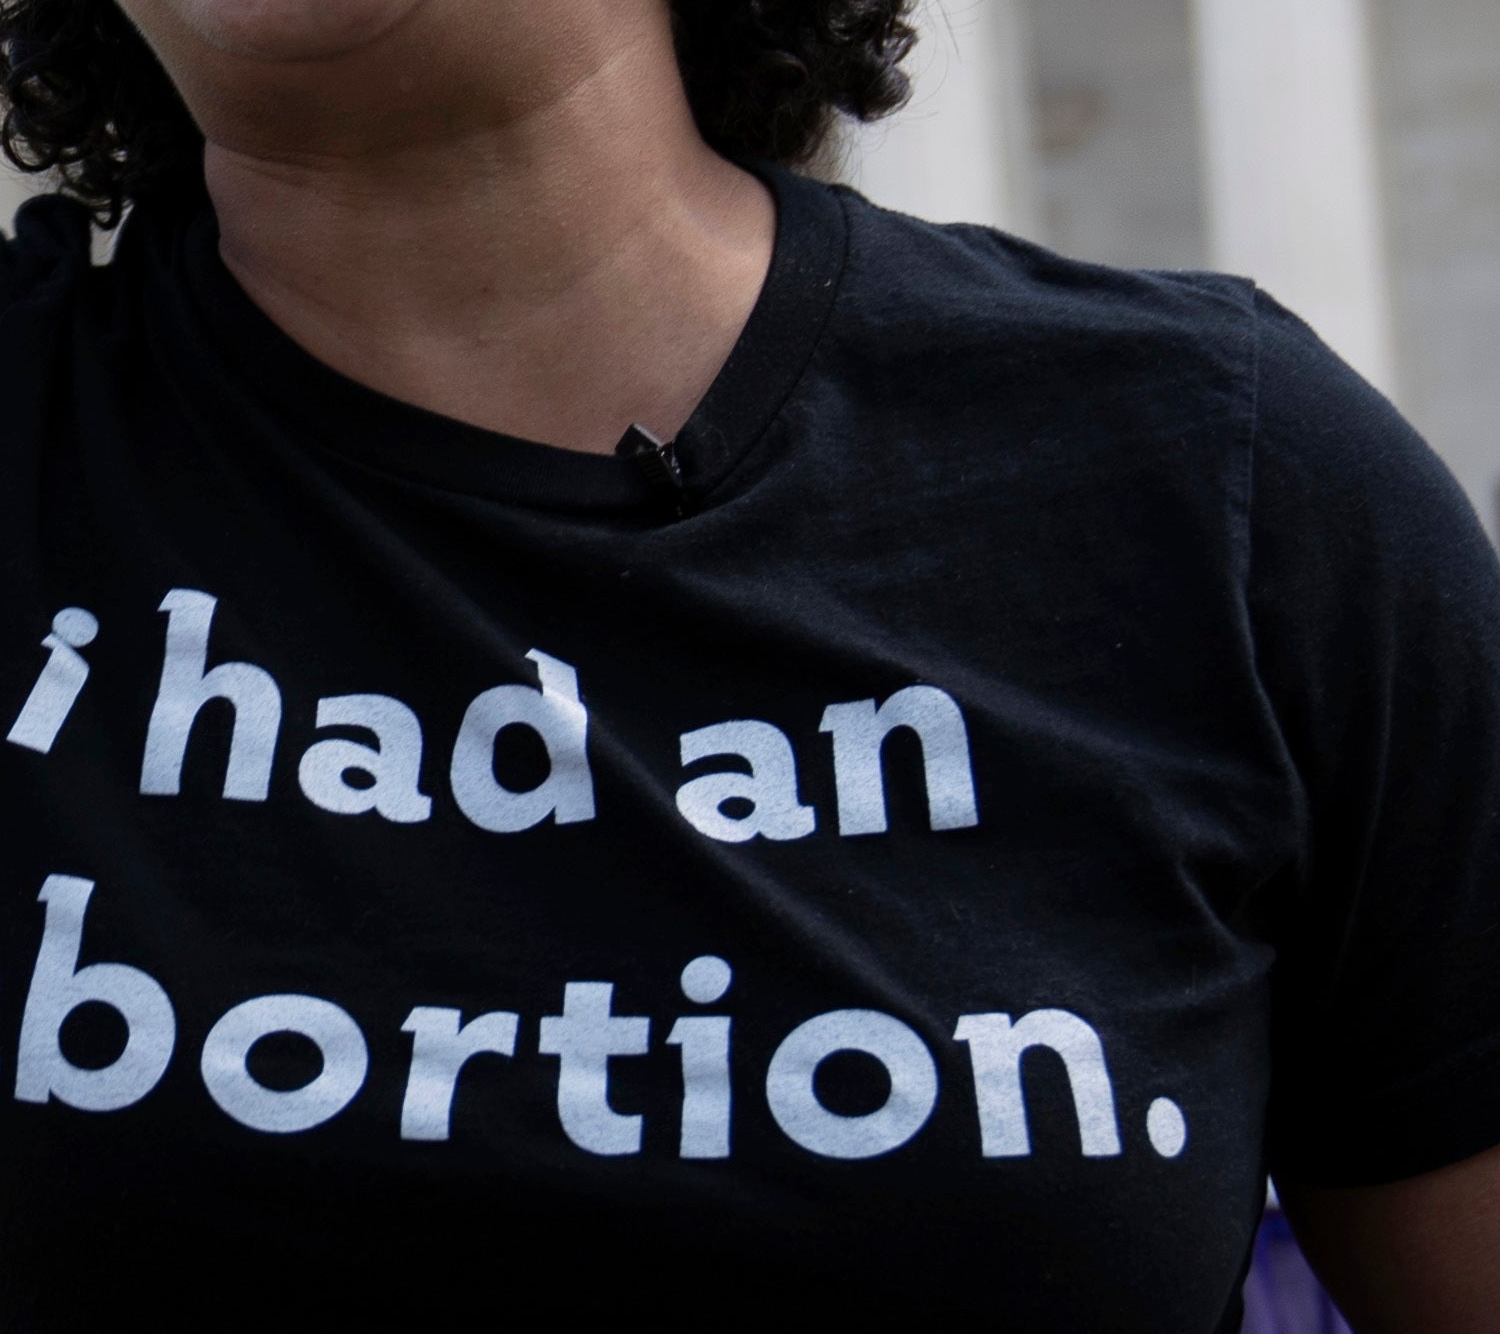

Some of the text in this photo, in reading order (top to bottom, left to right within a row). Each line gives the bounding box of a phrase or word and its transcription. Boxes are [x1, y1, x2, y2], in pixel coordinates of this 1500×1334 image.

[5, 587, 980, 843] i had an
